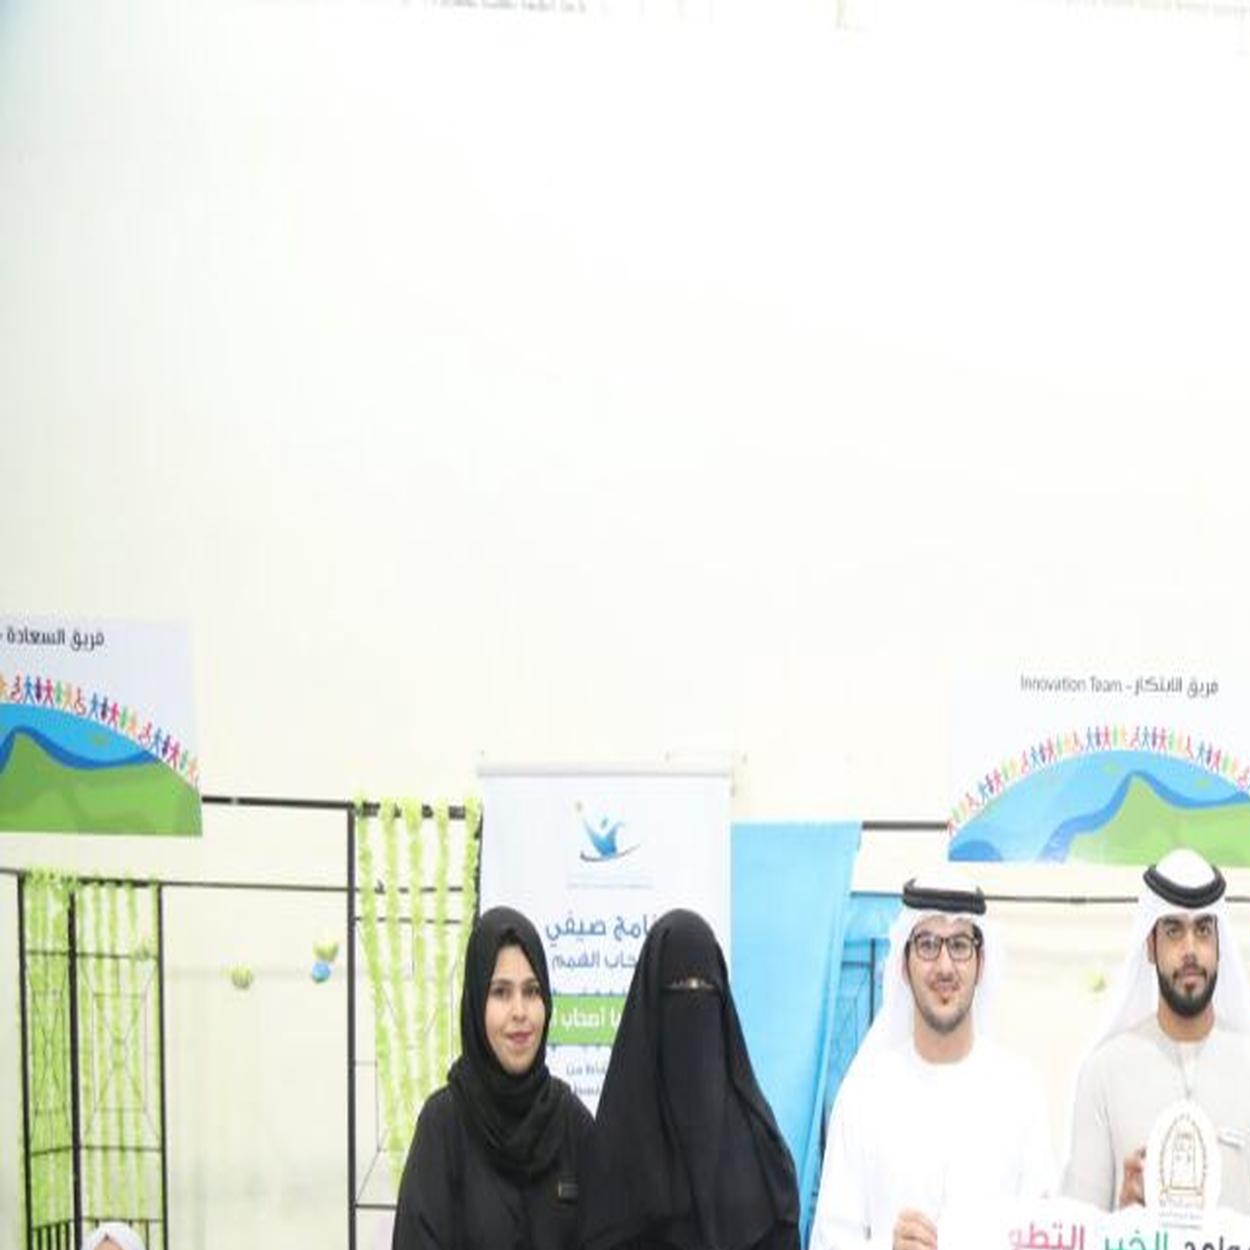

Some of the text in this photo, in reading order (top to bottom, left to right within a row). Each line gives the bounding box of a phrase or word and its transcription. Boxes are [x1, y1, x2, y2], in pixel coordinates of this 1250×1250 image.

[7, 625, 105, 651] فريق السعادة
[1020, 674, 1086, 693] Innovation
[1089, 674, 1123, 693] Team
[1187, 675, 1219, 699] فريق
[546, 909, 606, 948] صيفي
